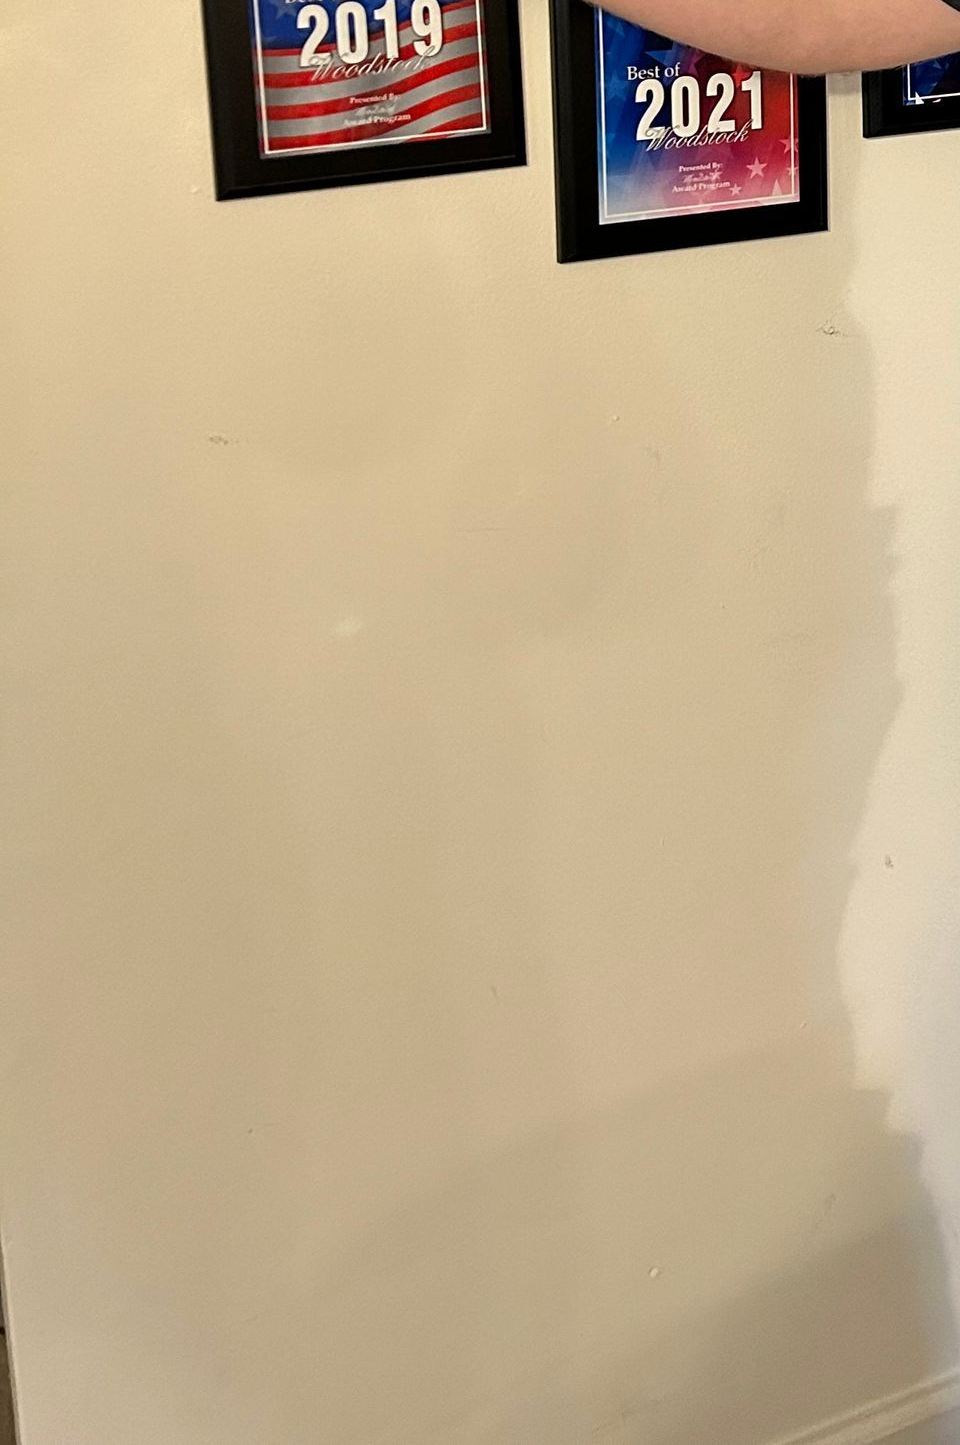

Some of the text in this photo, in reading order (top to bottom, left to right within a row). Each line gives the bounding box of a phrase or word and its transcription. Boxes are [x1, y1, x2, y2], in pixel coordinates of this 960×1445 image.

[627, 62, 680, 80] Best of
[635, 71, 762, 141] 2021
[645, 119, 753, 151] Woodstock
